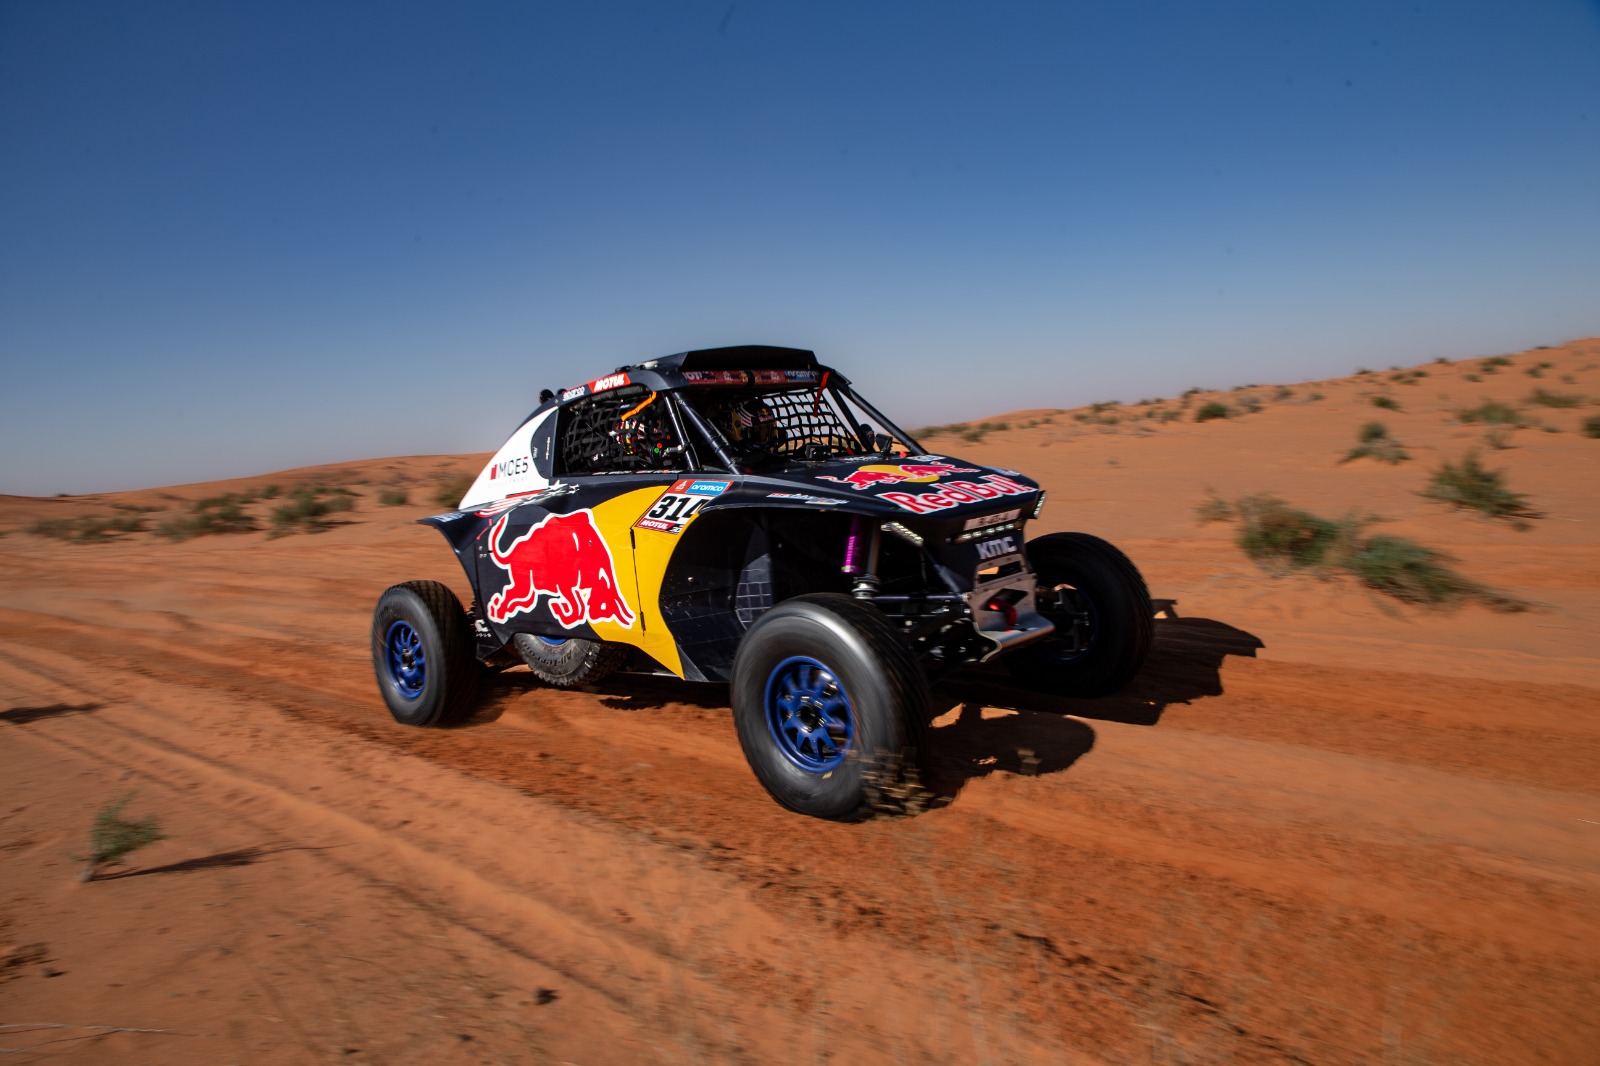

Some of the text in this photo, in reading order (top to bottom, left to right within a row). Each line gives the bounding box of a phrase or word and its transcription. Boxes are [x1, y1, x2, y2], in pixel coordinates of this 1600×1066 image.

[594, 374, 625, 392] MOTUL
[498, 456, 529, 478] MCE5
[691, 484, 724, 492] aramco
[640, 520, 669, 529] MOTUL
